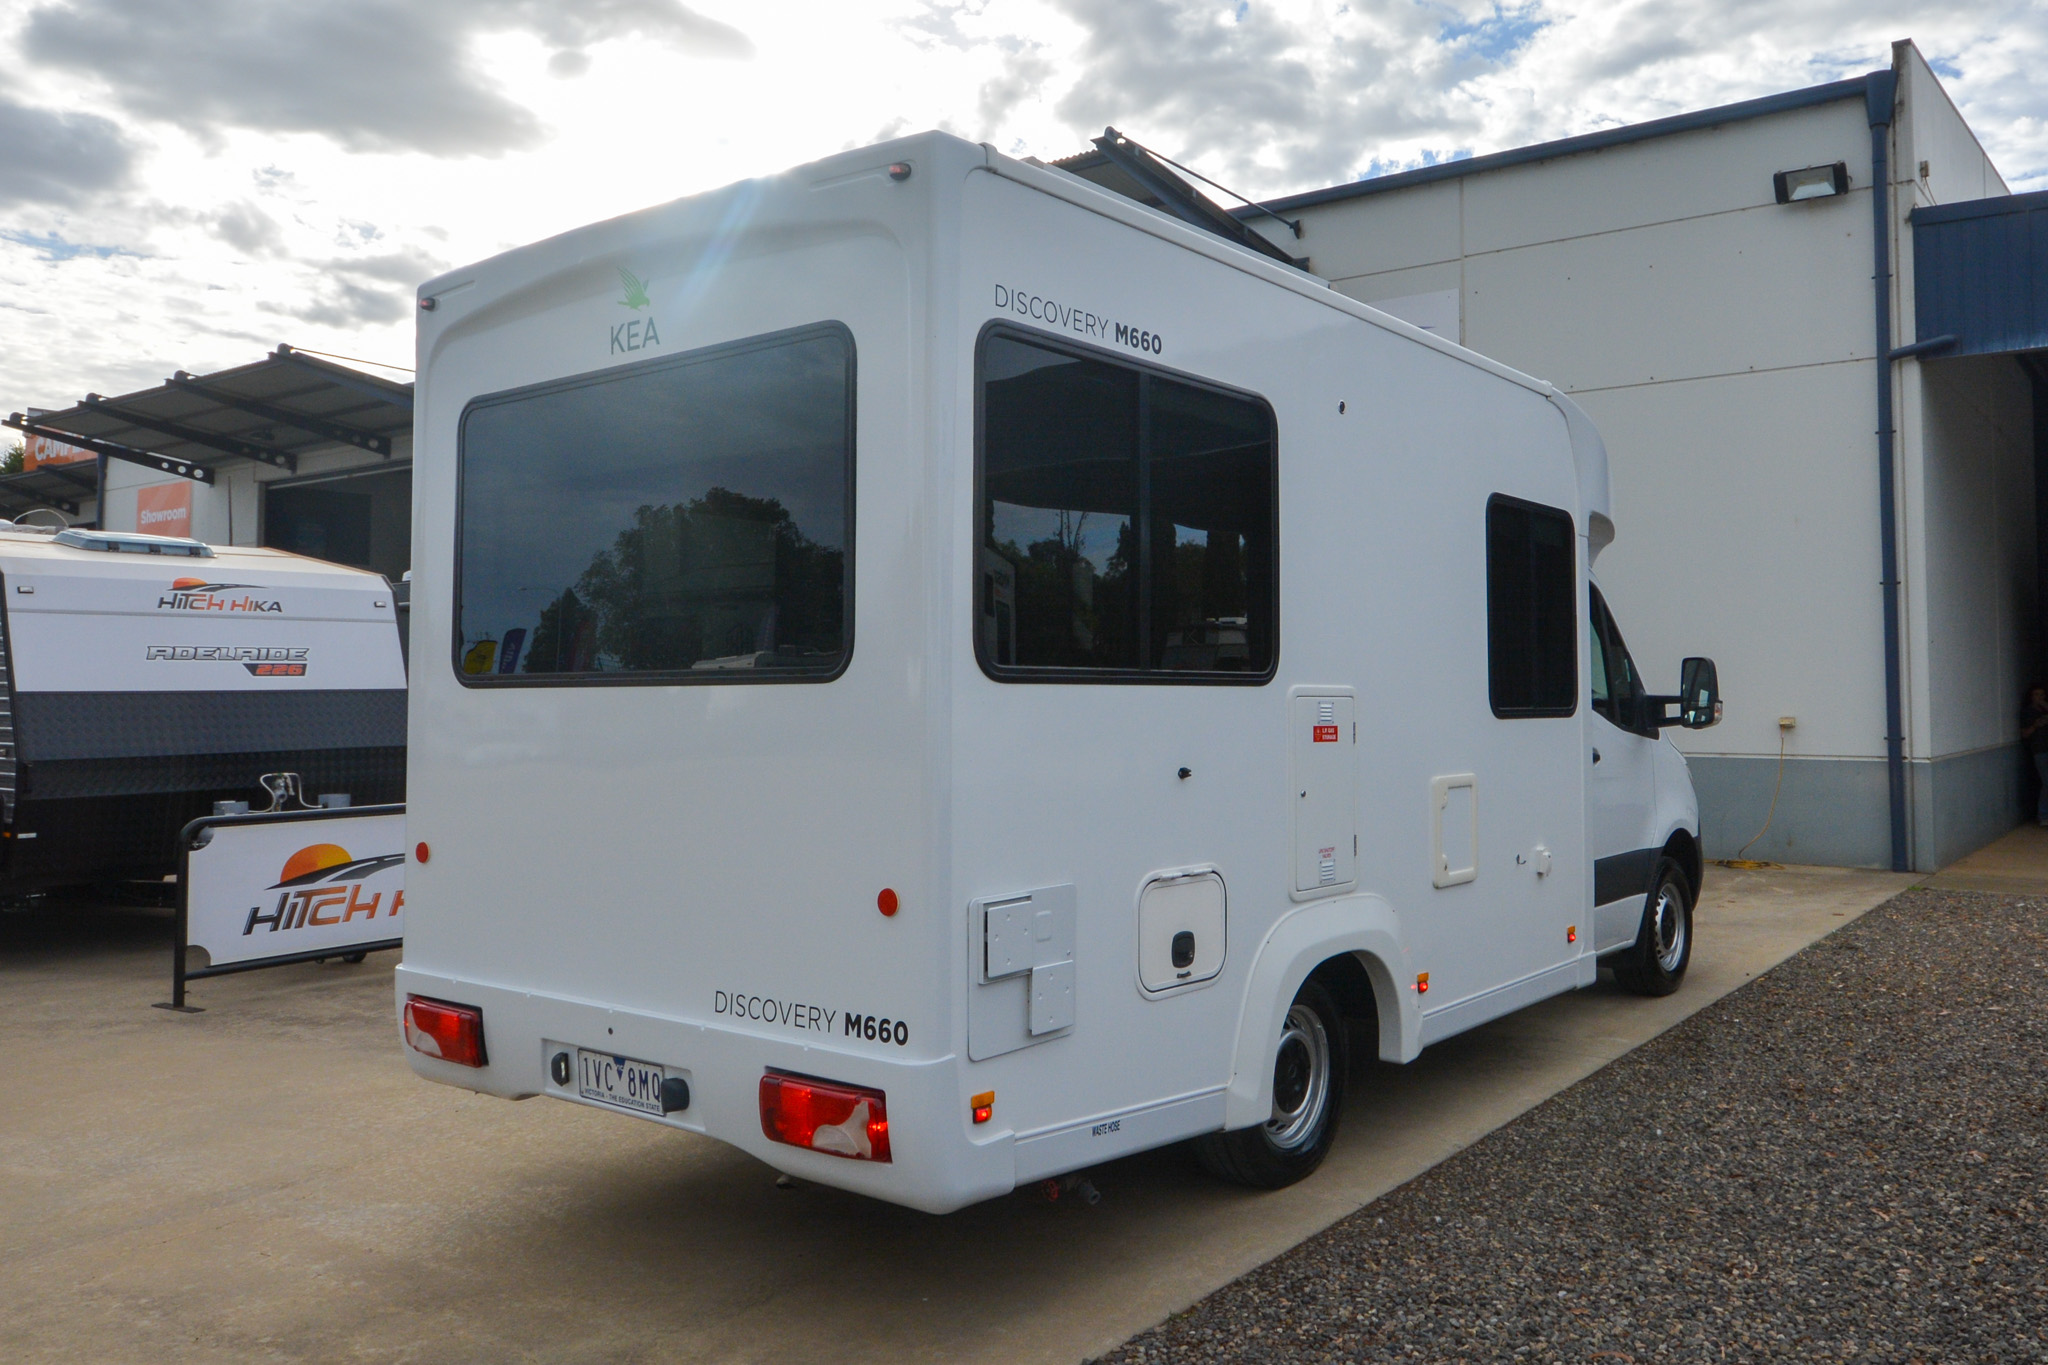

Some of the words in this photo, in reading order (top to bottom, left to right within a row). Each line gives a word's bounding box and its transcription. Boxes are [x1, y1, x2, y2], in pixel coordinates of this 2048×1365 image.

[995, 284, 1109, 338] DISCOVERY
[1115, 323, 1162, 354] M660
[611, 317, 660, 355] KEA
[35, 438, 85, 461] CAMP
[141, 507, 186, 524] Showroom
[157, 593, 225, 611] HITCH
[230, 596, 283, 613] HIKA
[146, 646, 310, 661] ADELAIDE
[256, 664, 304, 675] 226
[242, 884, 382, 936] HITCH
[714, 990, 837, 1033] DISCOVERY
[845, 1012, 909, 1046] M660
[584, 1057, 613, 1091] 1VC
[628, 1067, 660, 1102] 8MQ
[585, 1088, 604, 1098] VICTORIA
[609, 1093, 617, 1102] THE
[618, 1096, 645, 1108] EDUCATION
[645, 1102, 660, 1112] STATE
[1092, 1123, 1107, 1137] WASTE
[1108, 1120, 1120, 1133] HOSE
